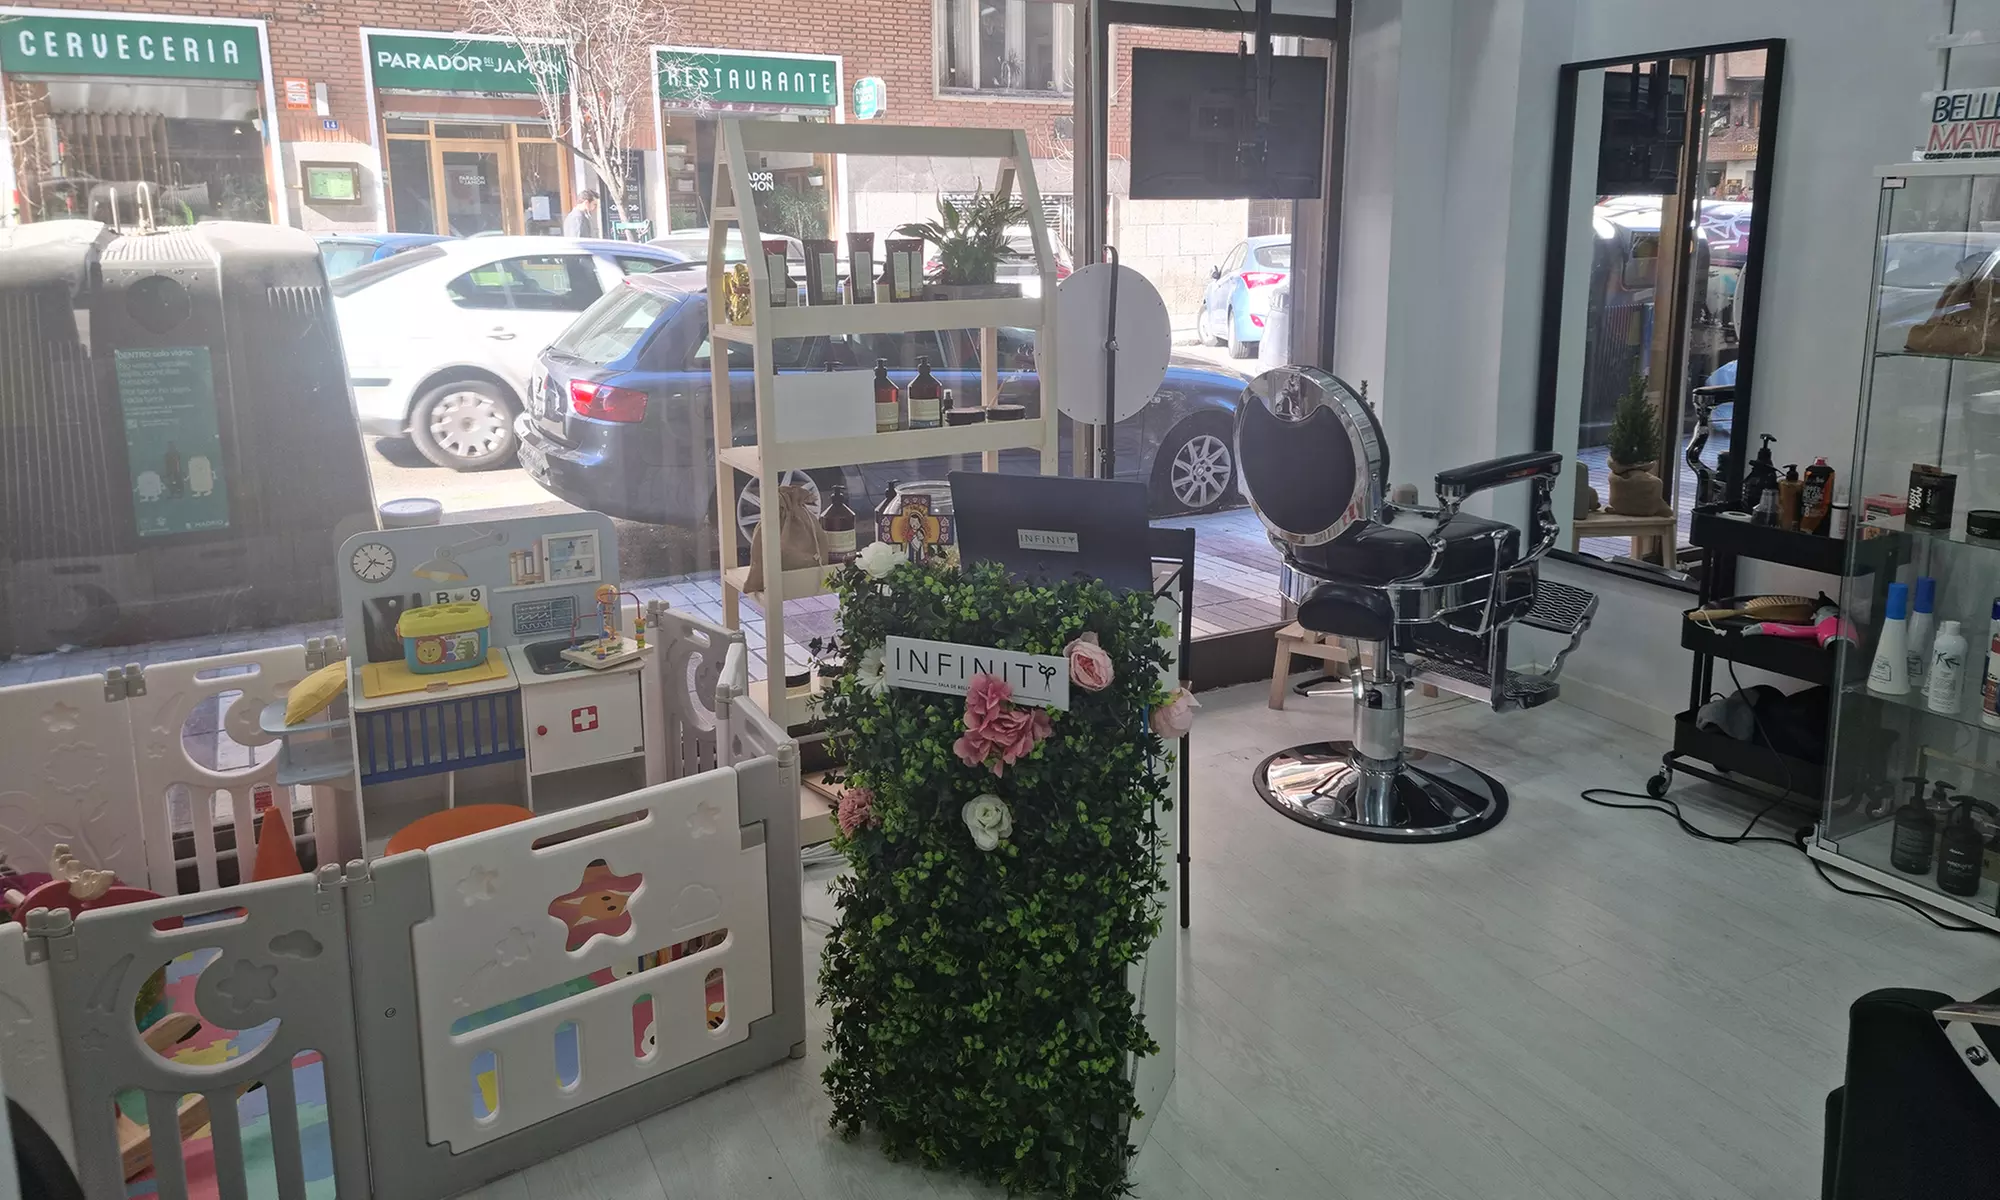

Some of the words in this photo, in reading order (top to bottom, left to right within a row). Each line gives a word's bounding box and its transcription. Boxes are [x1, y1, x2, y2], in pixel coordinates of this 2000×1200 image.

[19, 30, 239, 64] CERVECERIA
[377, 51, 483, 73] PARADOR
[668, 67, 831, 93] RESTAURANTE
[436, 592, 450, 604] B
[470, 588, 480, 601] 9
